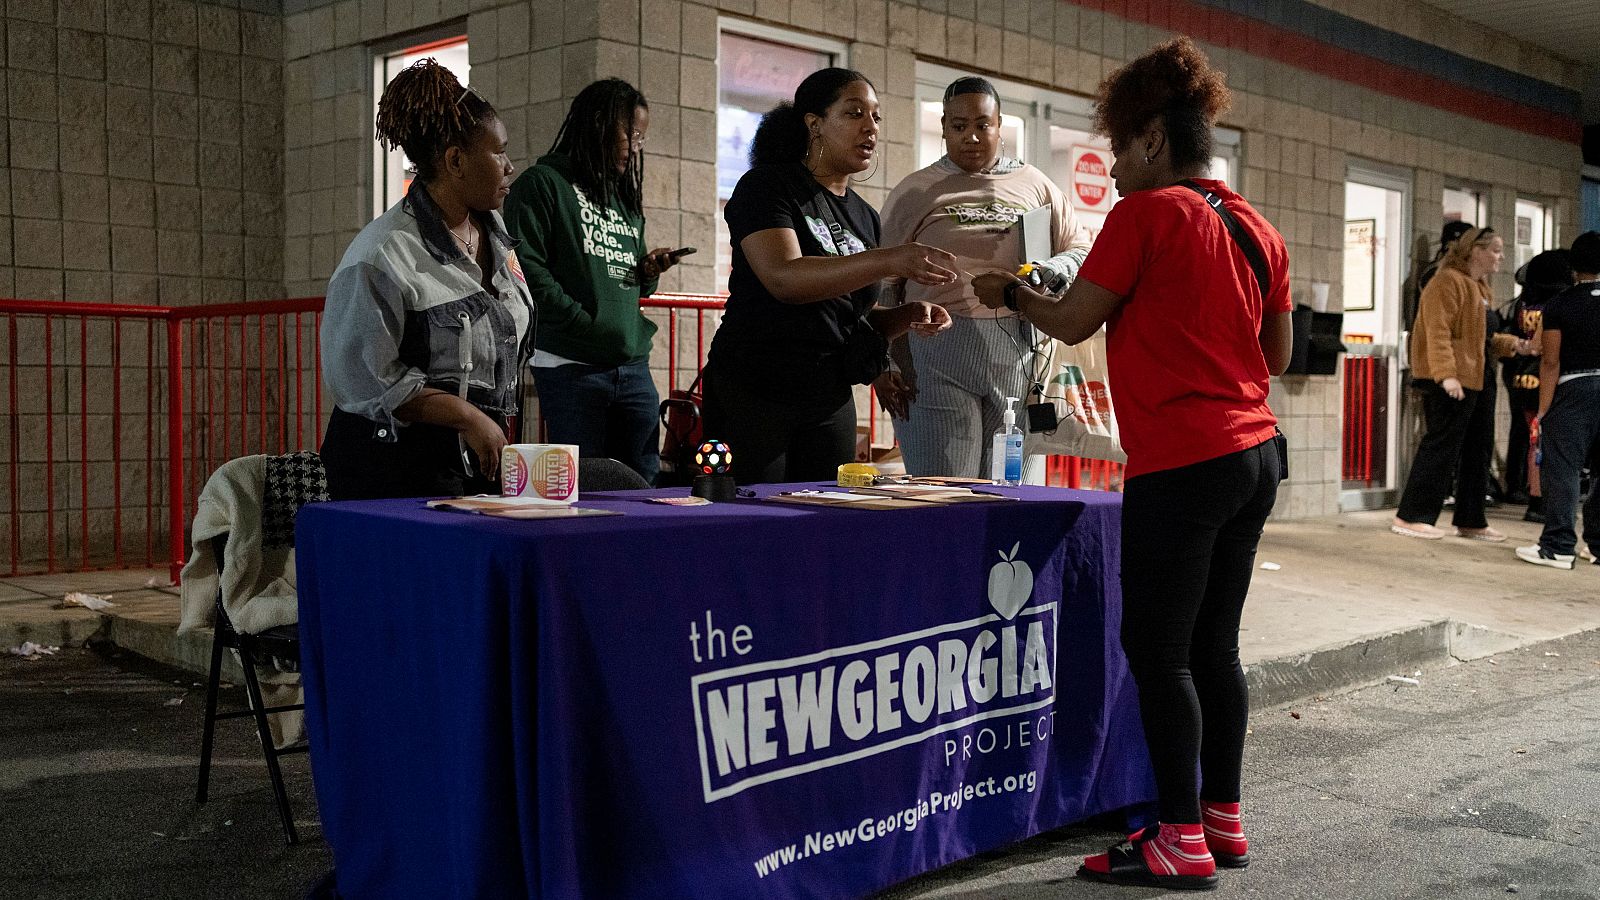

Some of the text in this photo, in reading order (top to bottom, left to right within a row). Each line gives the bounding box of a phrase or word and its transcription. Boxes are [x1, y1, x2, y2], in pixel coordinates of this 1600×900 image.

[1079, 160, 1104, 176] DO NOT
[1080, 185, 1102, 198] ENTER
[581, 223, 622, 249] Vote.
[583, 238, 637, 267] Repeat.
[547, 454, 559, 490] VOTED
[559, 465, 568, 497] EARLY
[689, 610, 753, 663] the
[944, 711, 1057, 766] PROJECT
[755, 771, 1037, 879] www.NewGeorgiaProject.org
